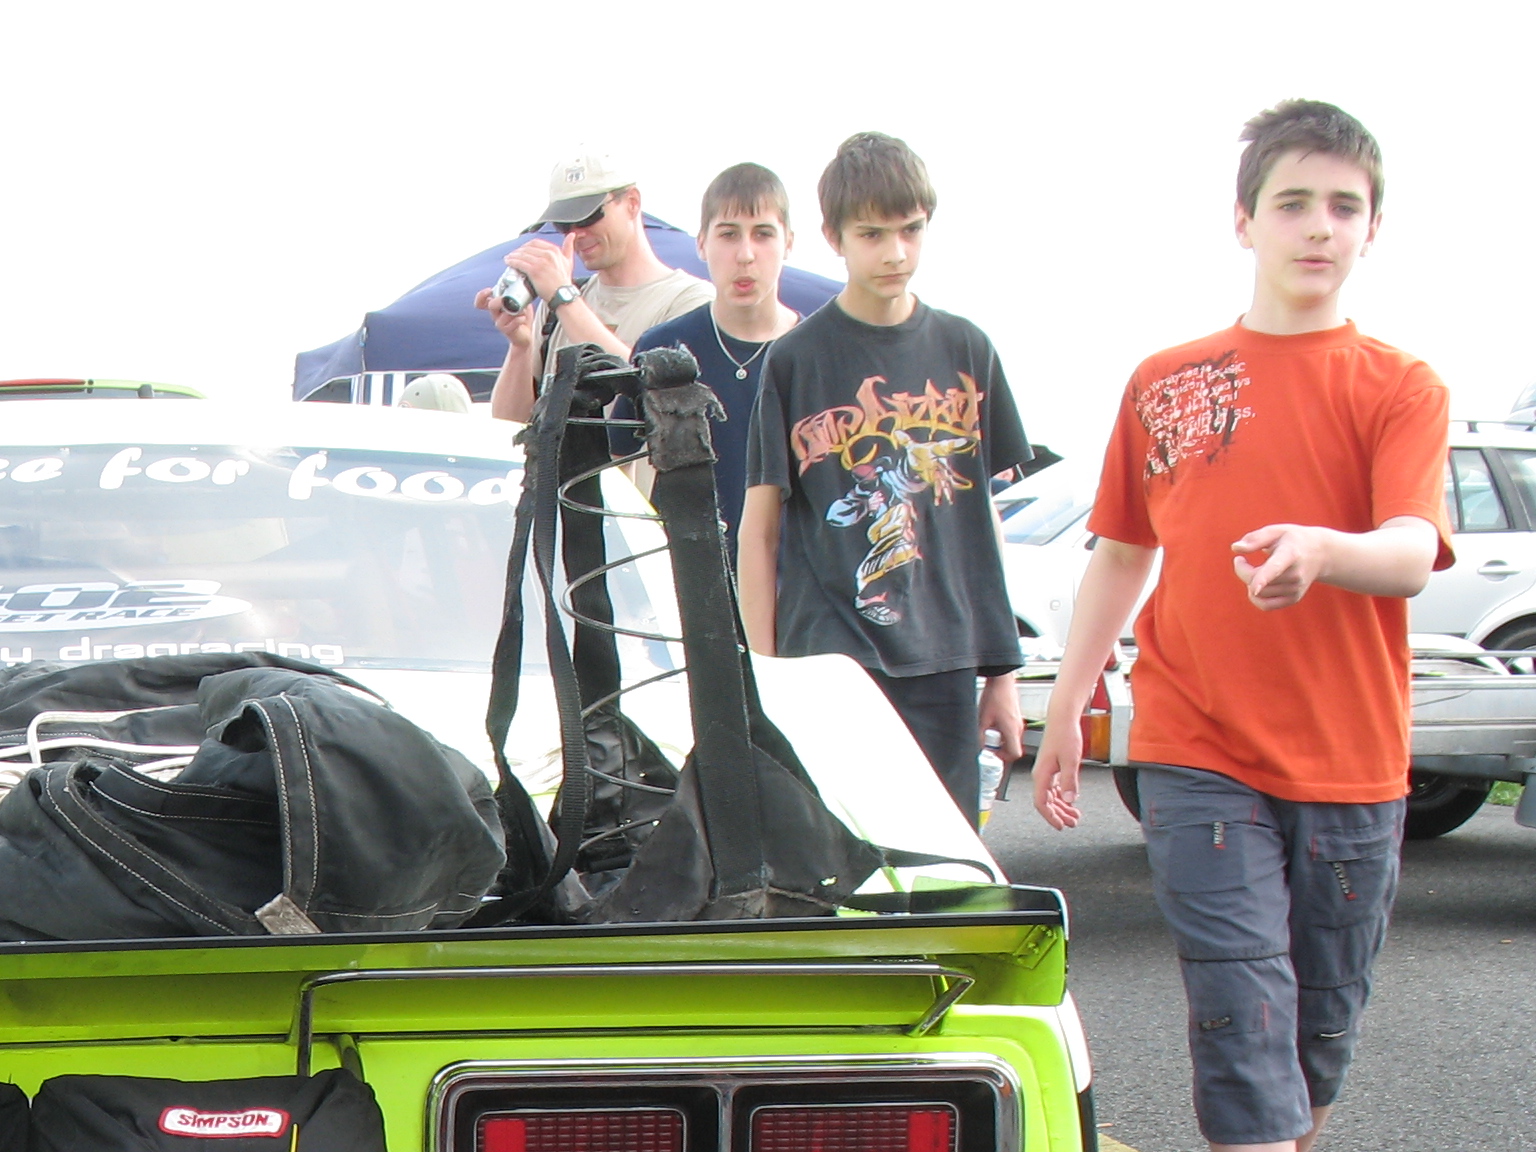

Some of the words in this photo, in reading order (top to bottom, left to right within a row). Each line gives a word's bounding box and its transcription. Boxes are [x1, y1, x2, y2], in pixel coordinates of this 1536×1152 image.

[99, 446, 250, 490] for
[289, 452, 524, 506] food
[67, 607, 200, 621] RACE
[177, 1113, 268, 1129] SIMPSON
